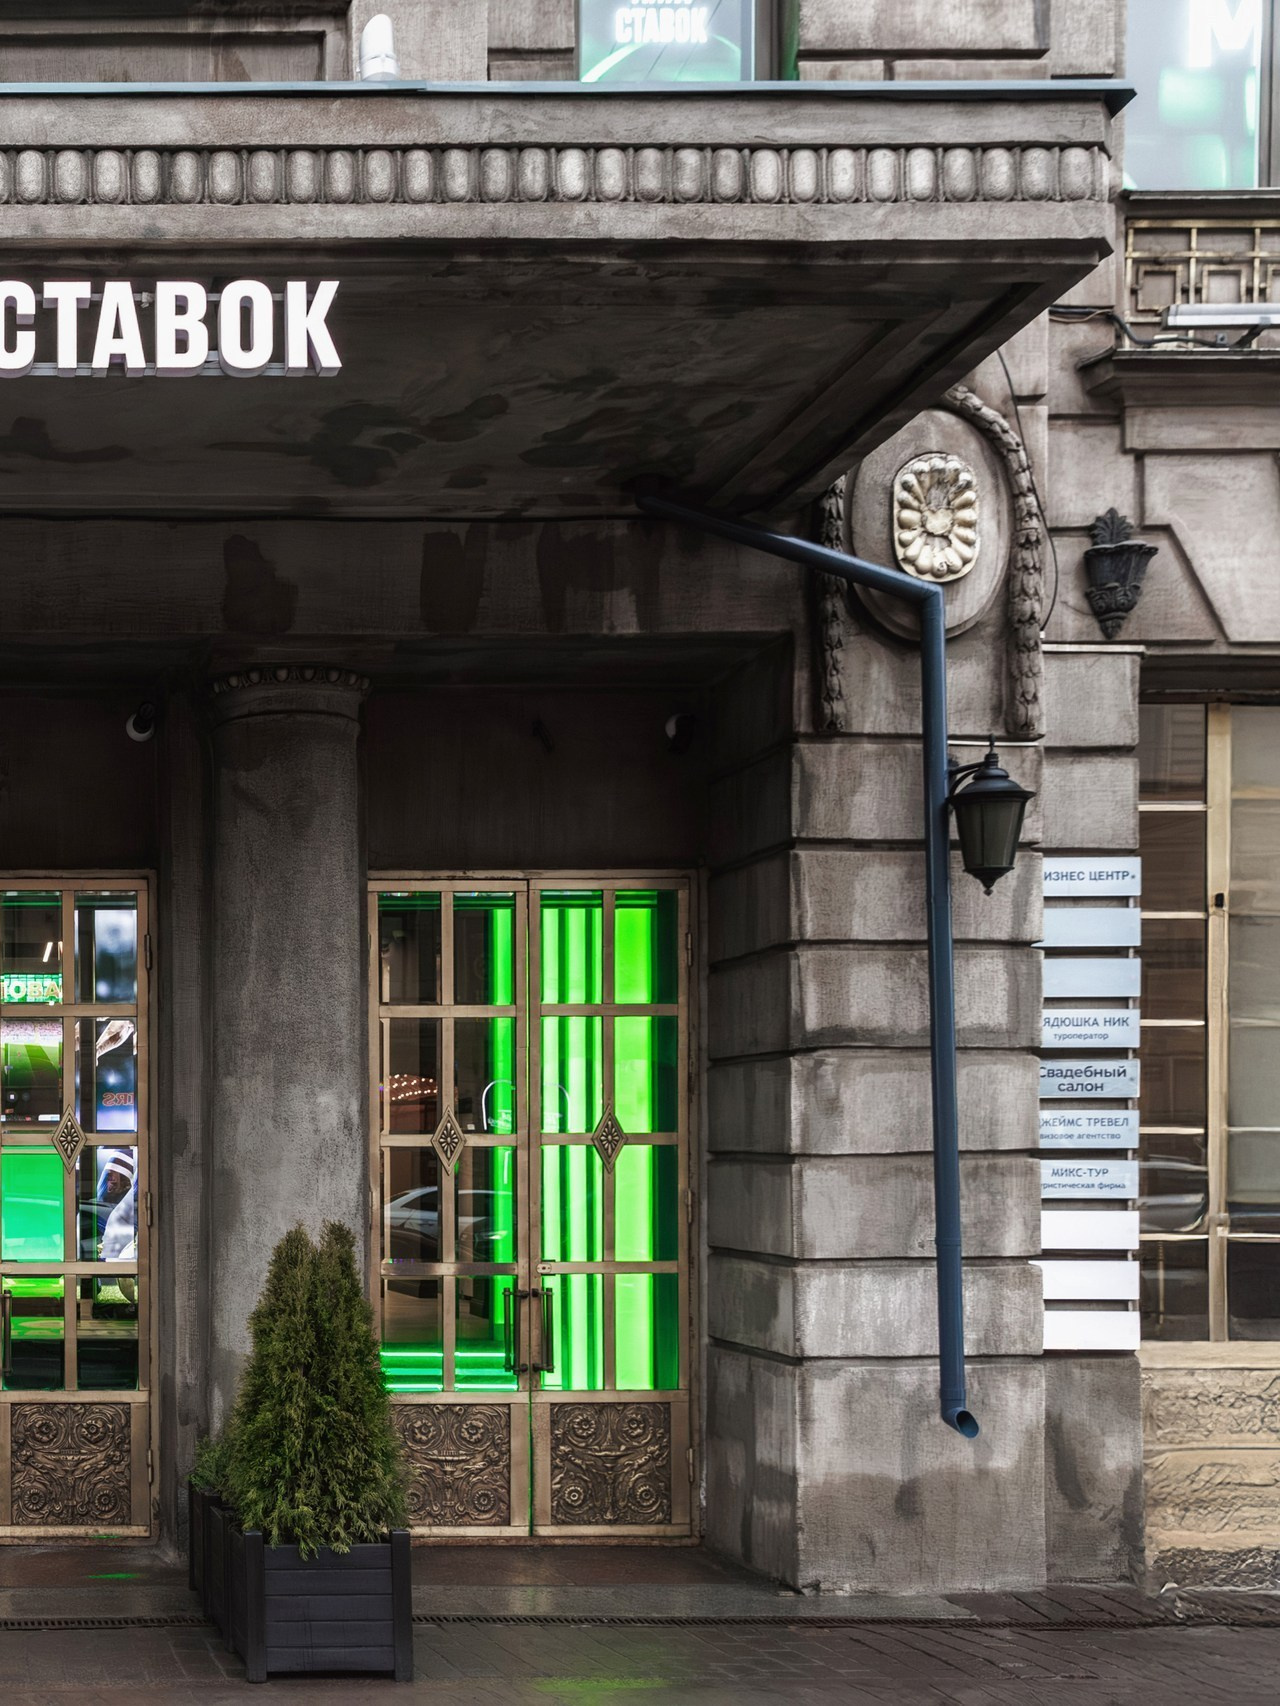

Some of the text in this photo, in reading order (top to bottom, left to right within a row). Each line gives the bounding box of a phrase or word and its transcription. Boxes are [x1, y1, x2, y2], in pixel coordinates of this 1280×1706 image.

[616, 8, 709, 43] СТАВОК
[1043, 870, 1130, 882] ИЗНЕС ЦЕНТР
[1042, 1016, 1130, 1028] ЯДЮШКА НИК
[1053, 1033, 1109, 1041] туроператор
[1039, 1065, 1127, 1079] Свадебный
[1057, 1080, 1105, 1092] салон
[1039, 1115, 1130, 1128] ЖЕЙМС ТРЕВЕЛ
[1076, 1132, 1121, 1140] агентство
[1050, 1167, 1110, 1178] МИКС-ТУР
[1041, 1181, 1127, 1191] ристическая фирма
